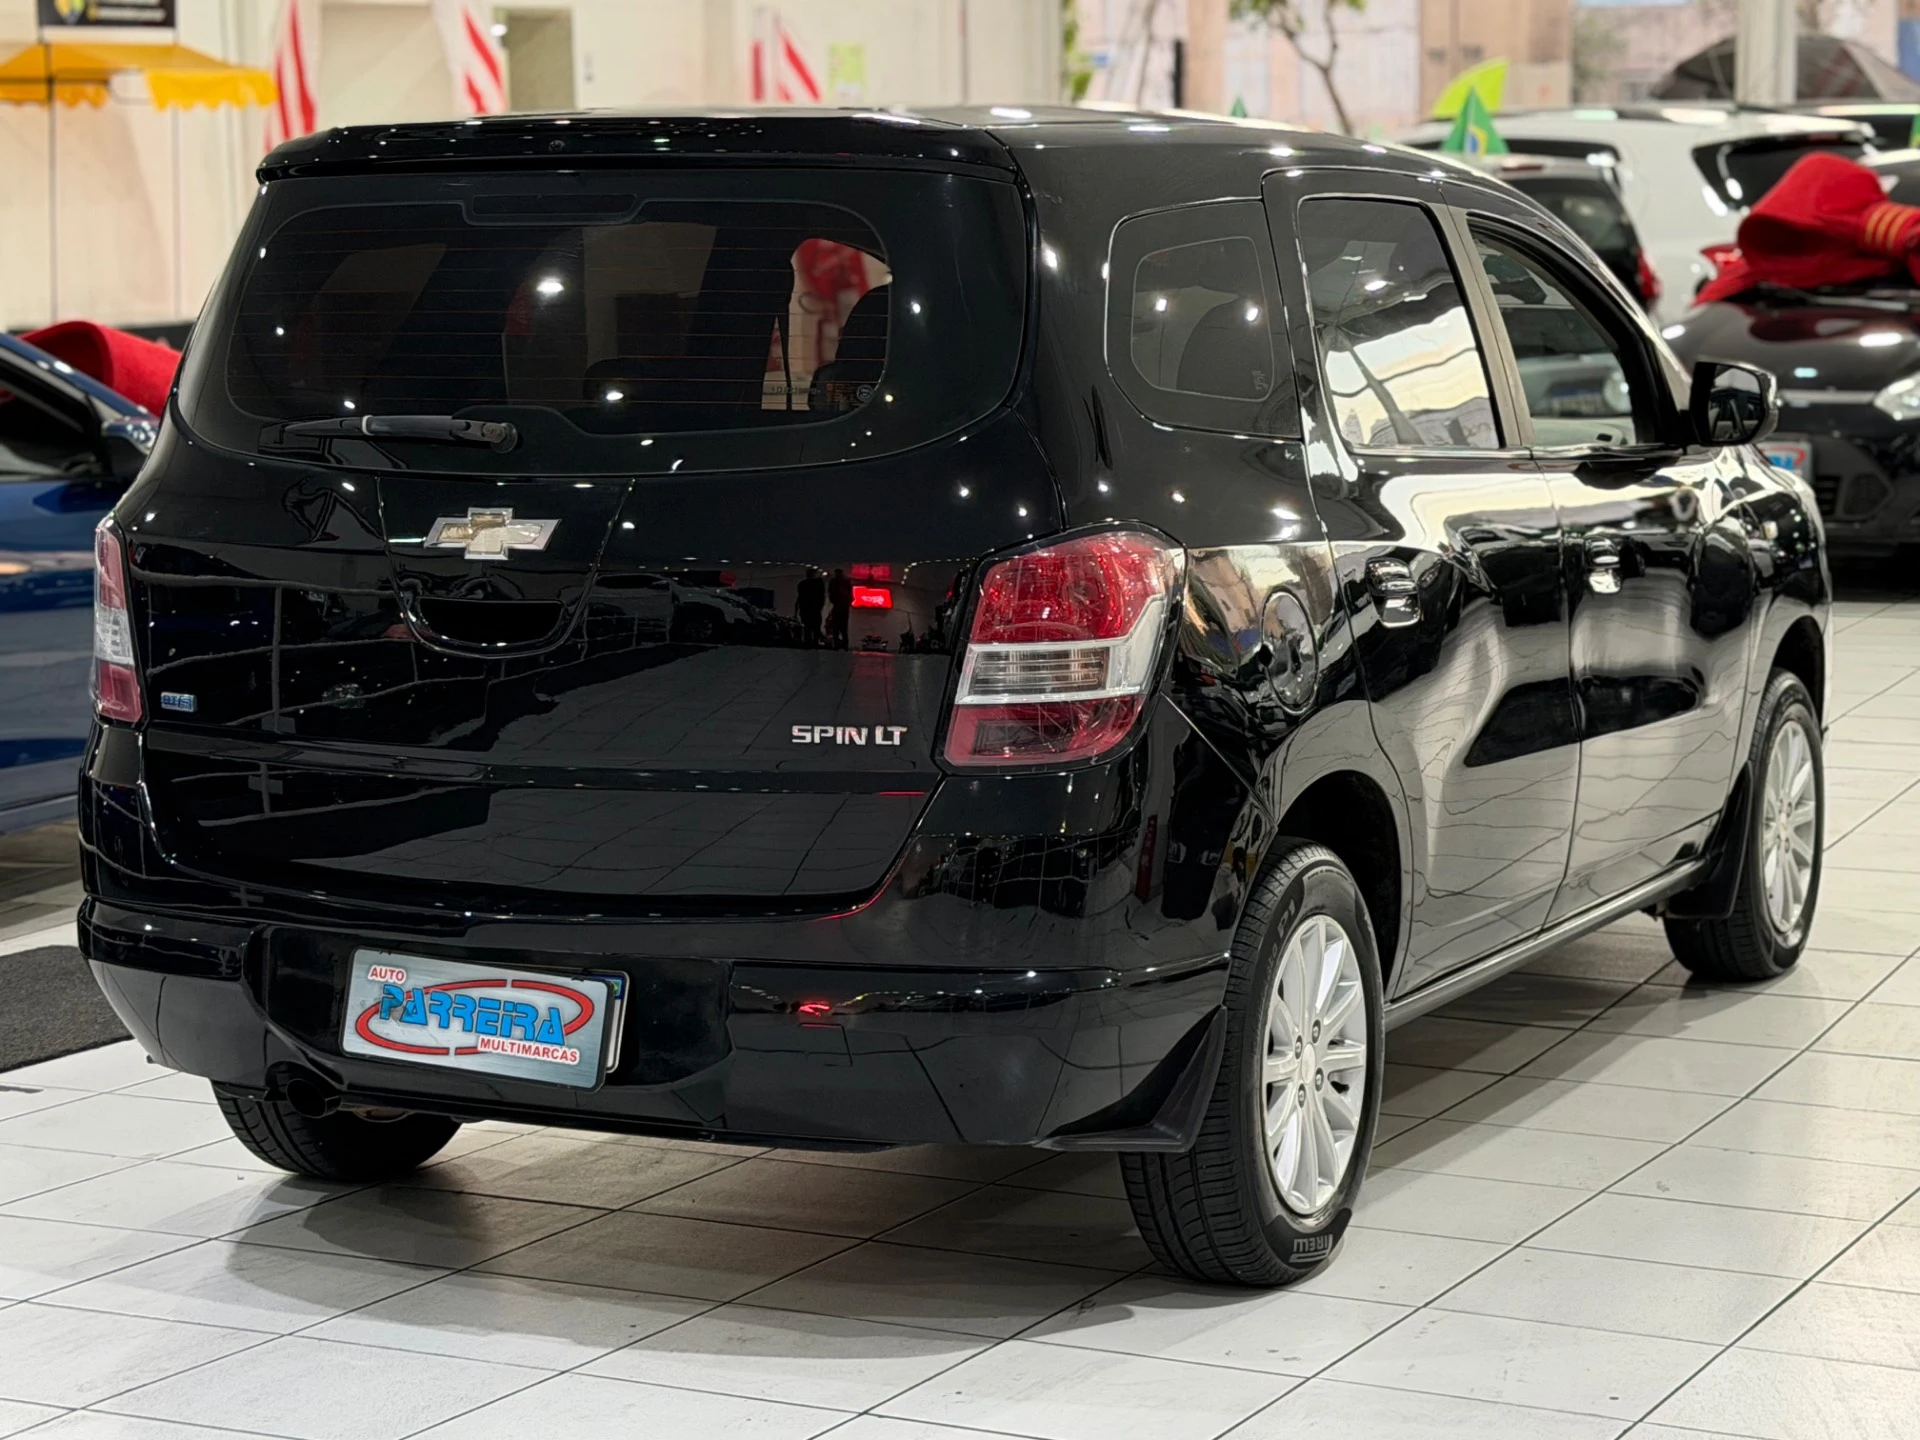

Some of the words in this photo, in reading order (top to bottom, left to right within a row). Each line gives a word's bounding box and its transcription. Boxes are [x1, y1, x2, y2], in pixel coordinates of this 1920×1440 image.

[791, 725, 868, 746] SPIN
[875, 725, 908, 746] LT
[369, 966, 406, 982] AUTO
[379, 983, 566, 1047] PARREIRA
[479, 1037, 579, 1063] MULTIMARCAS
[1288, 1233, 1334, 1263] PIRELLI
